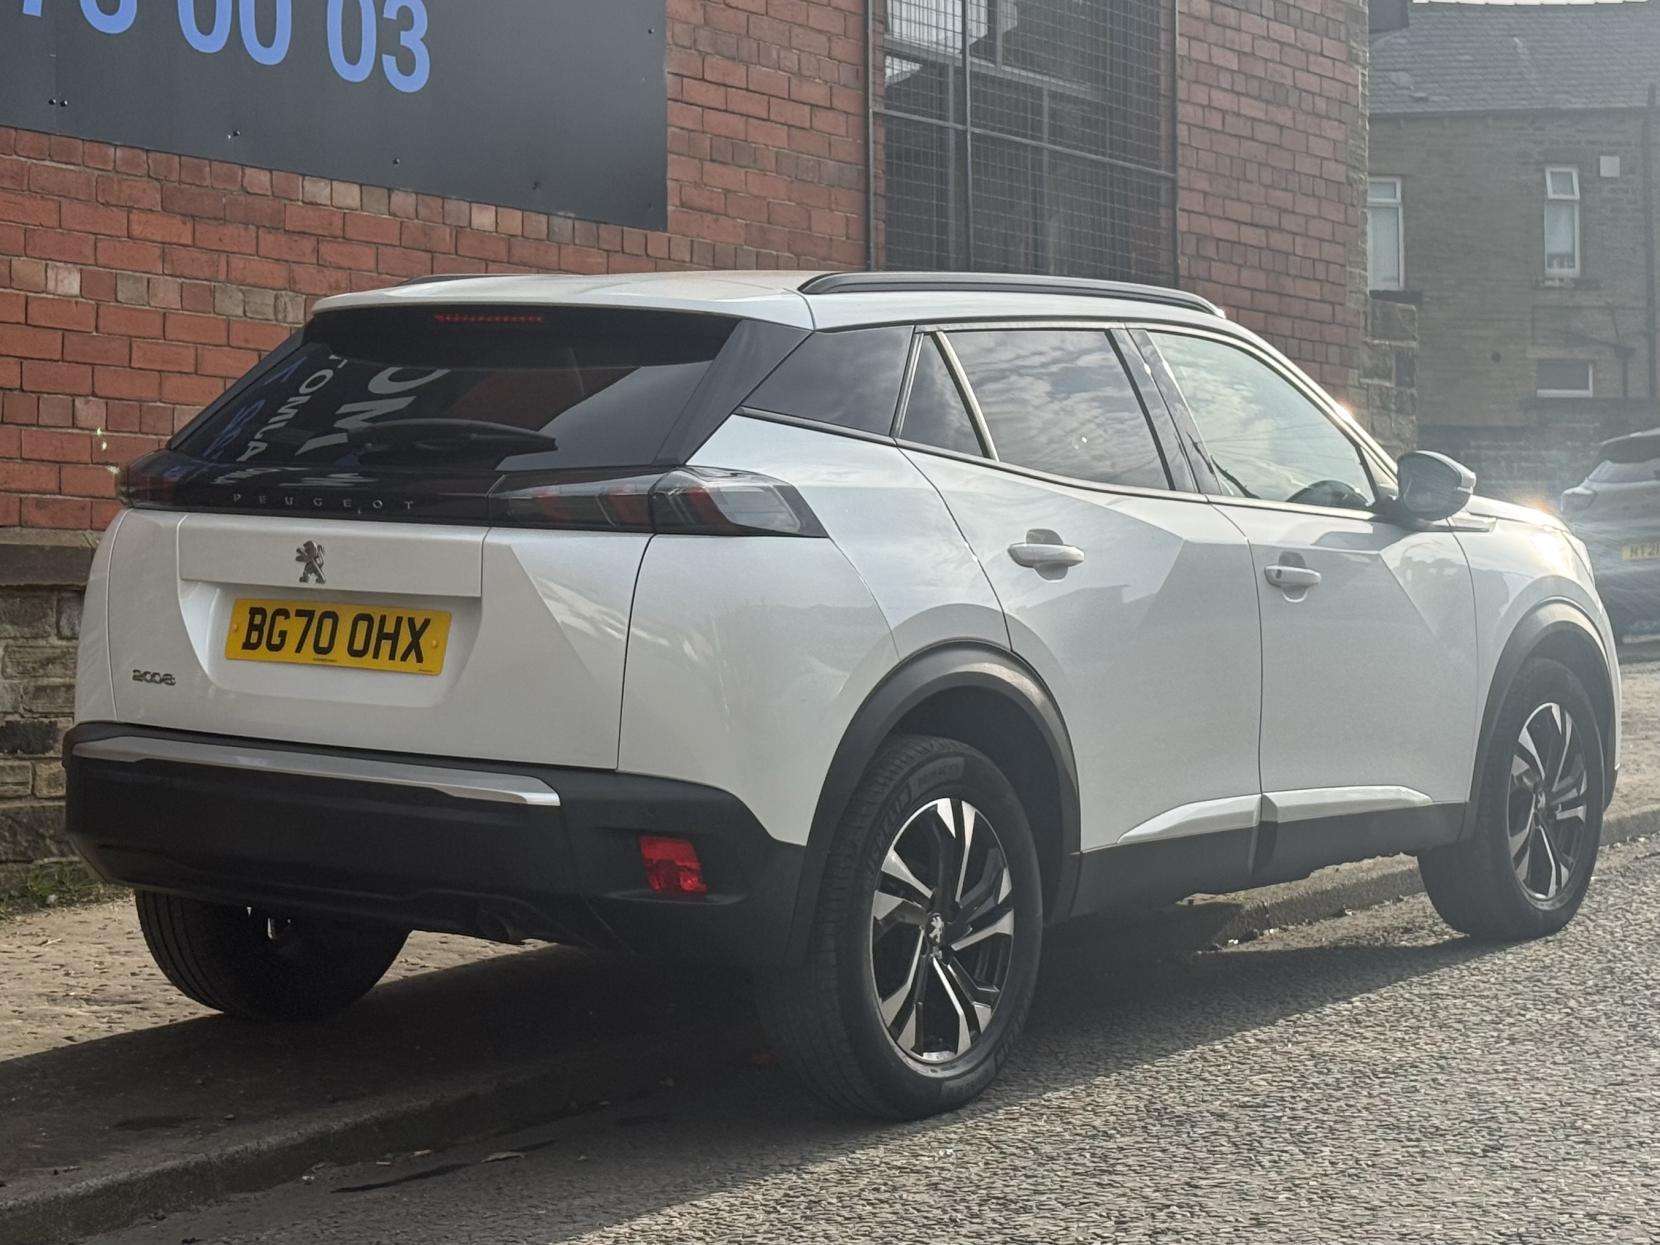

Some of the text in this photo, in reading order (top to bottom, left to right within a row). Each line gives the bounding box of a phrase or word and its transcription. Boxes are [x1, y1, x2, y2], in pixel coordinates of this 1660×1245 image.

[327, 0, 431, 93] 03
[232, 493, 414, 510] PEUGEOT
[241, 606, 431, 664] BG70 OHX
[132, 669, 177, 686] 2008
